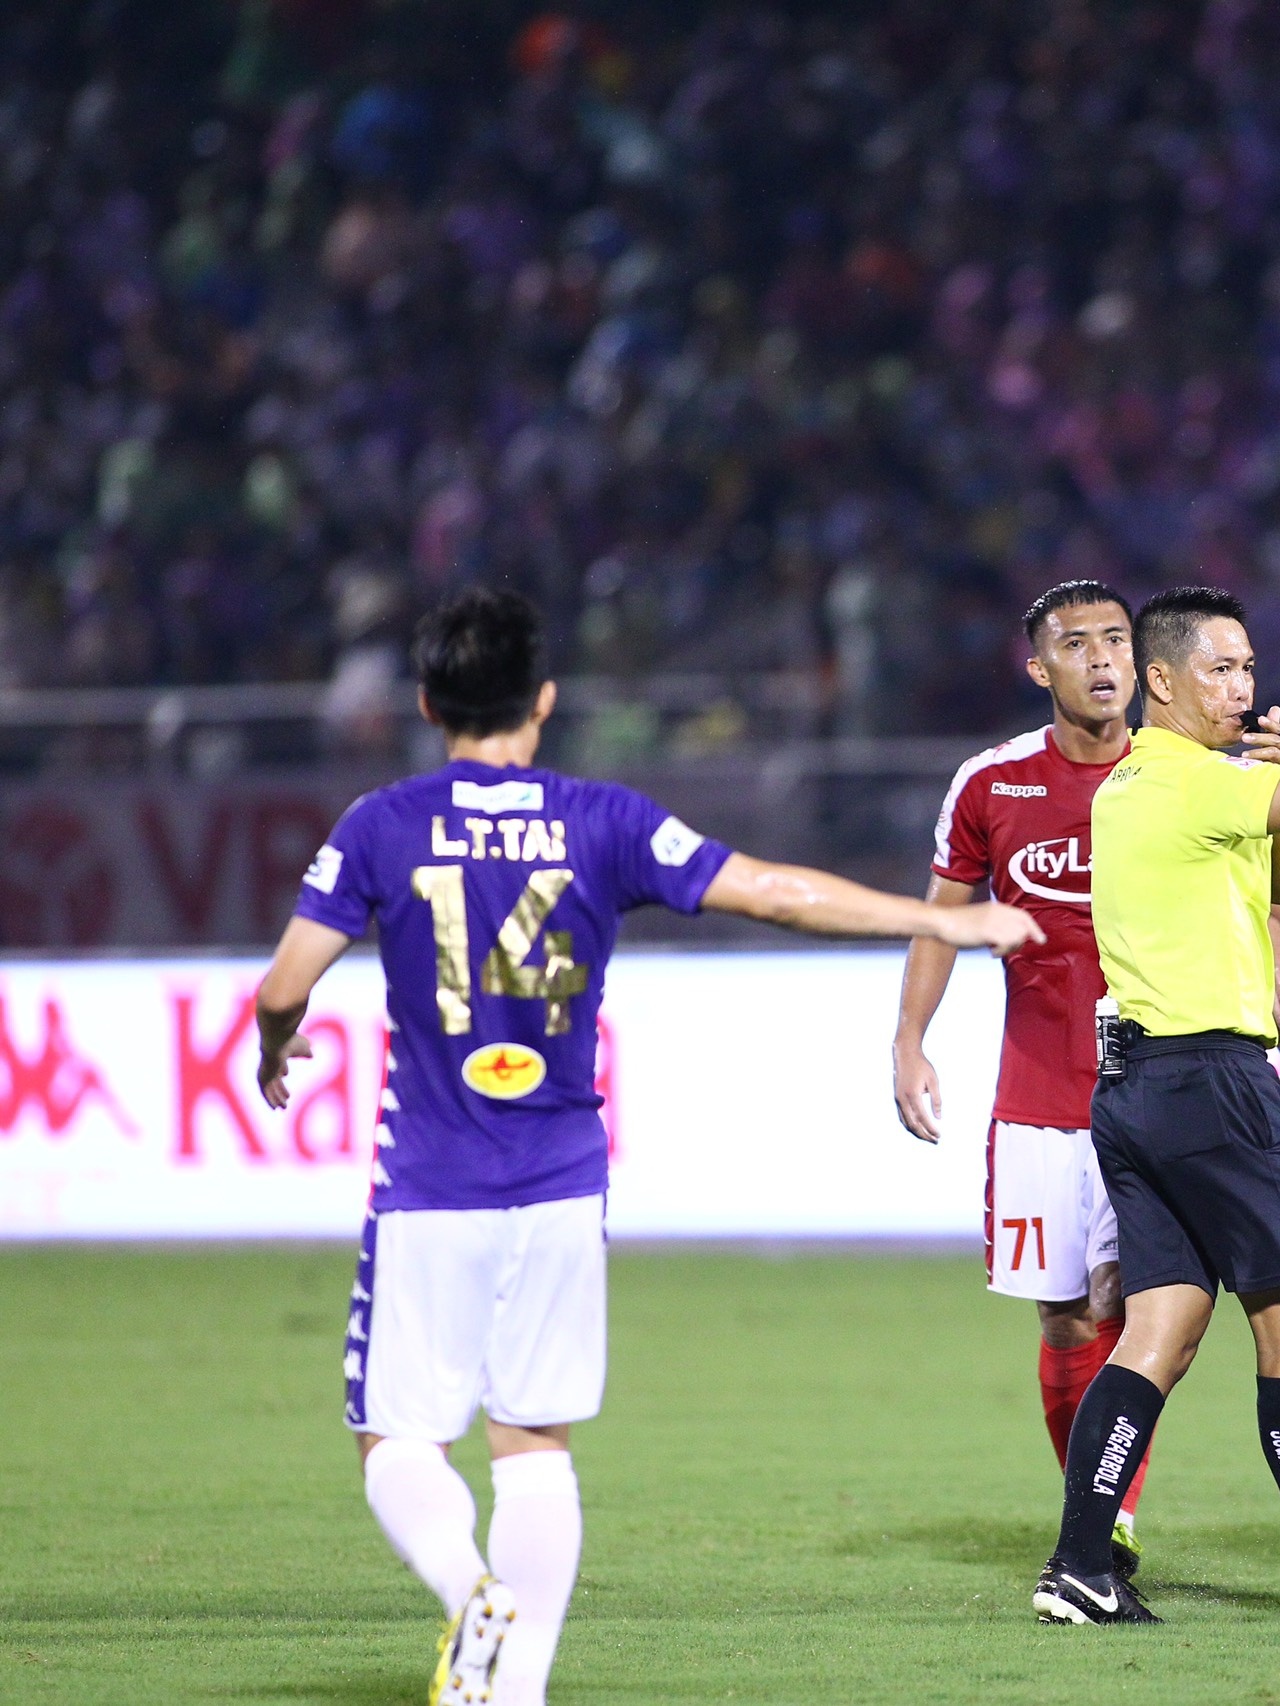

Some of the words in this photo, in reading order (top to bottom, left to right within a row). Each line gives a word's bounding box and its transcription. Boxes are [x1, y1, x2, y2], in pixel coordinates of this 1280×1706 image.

[990, 781, 1048, 798] Kappa
[413, 865, 589, 1037] 14
[1002, 1217, 1046, 1271] 71
[1092, 1415, 1139, 1497] JOGARBOLA
